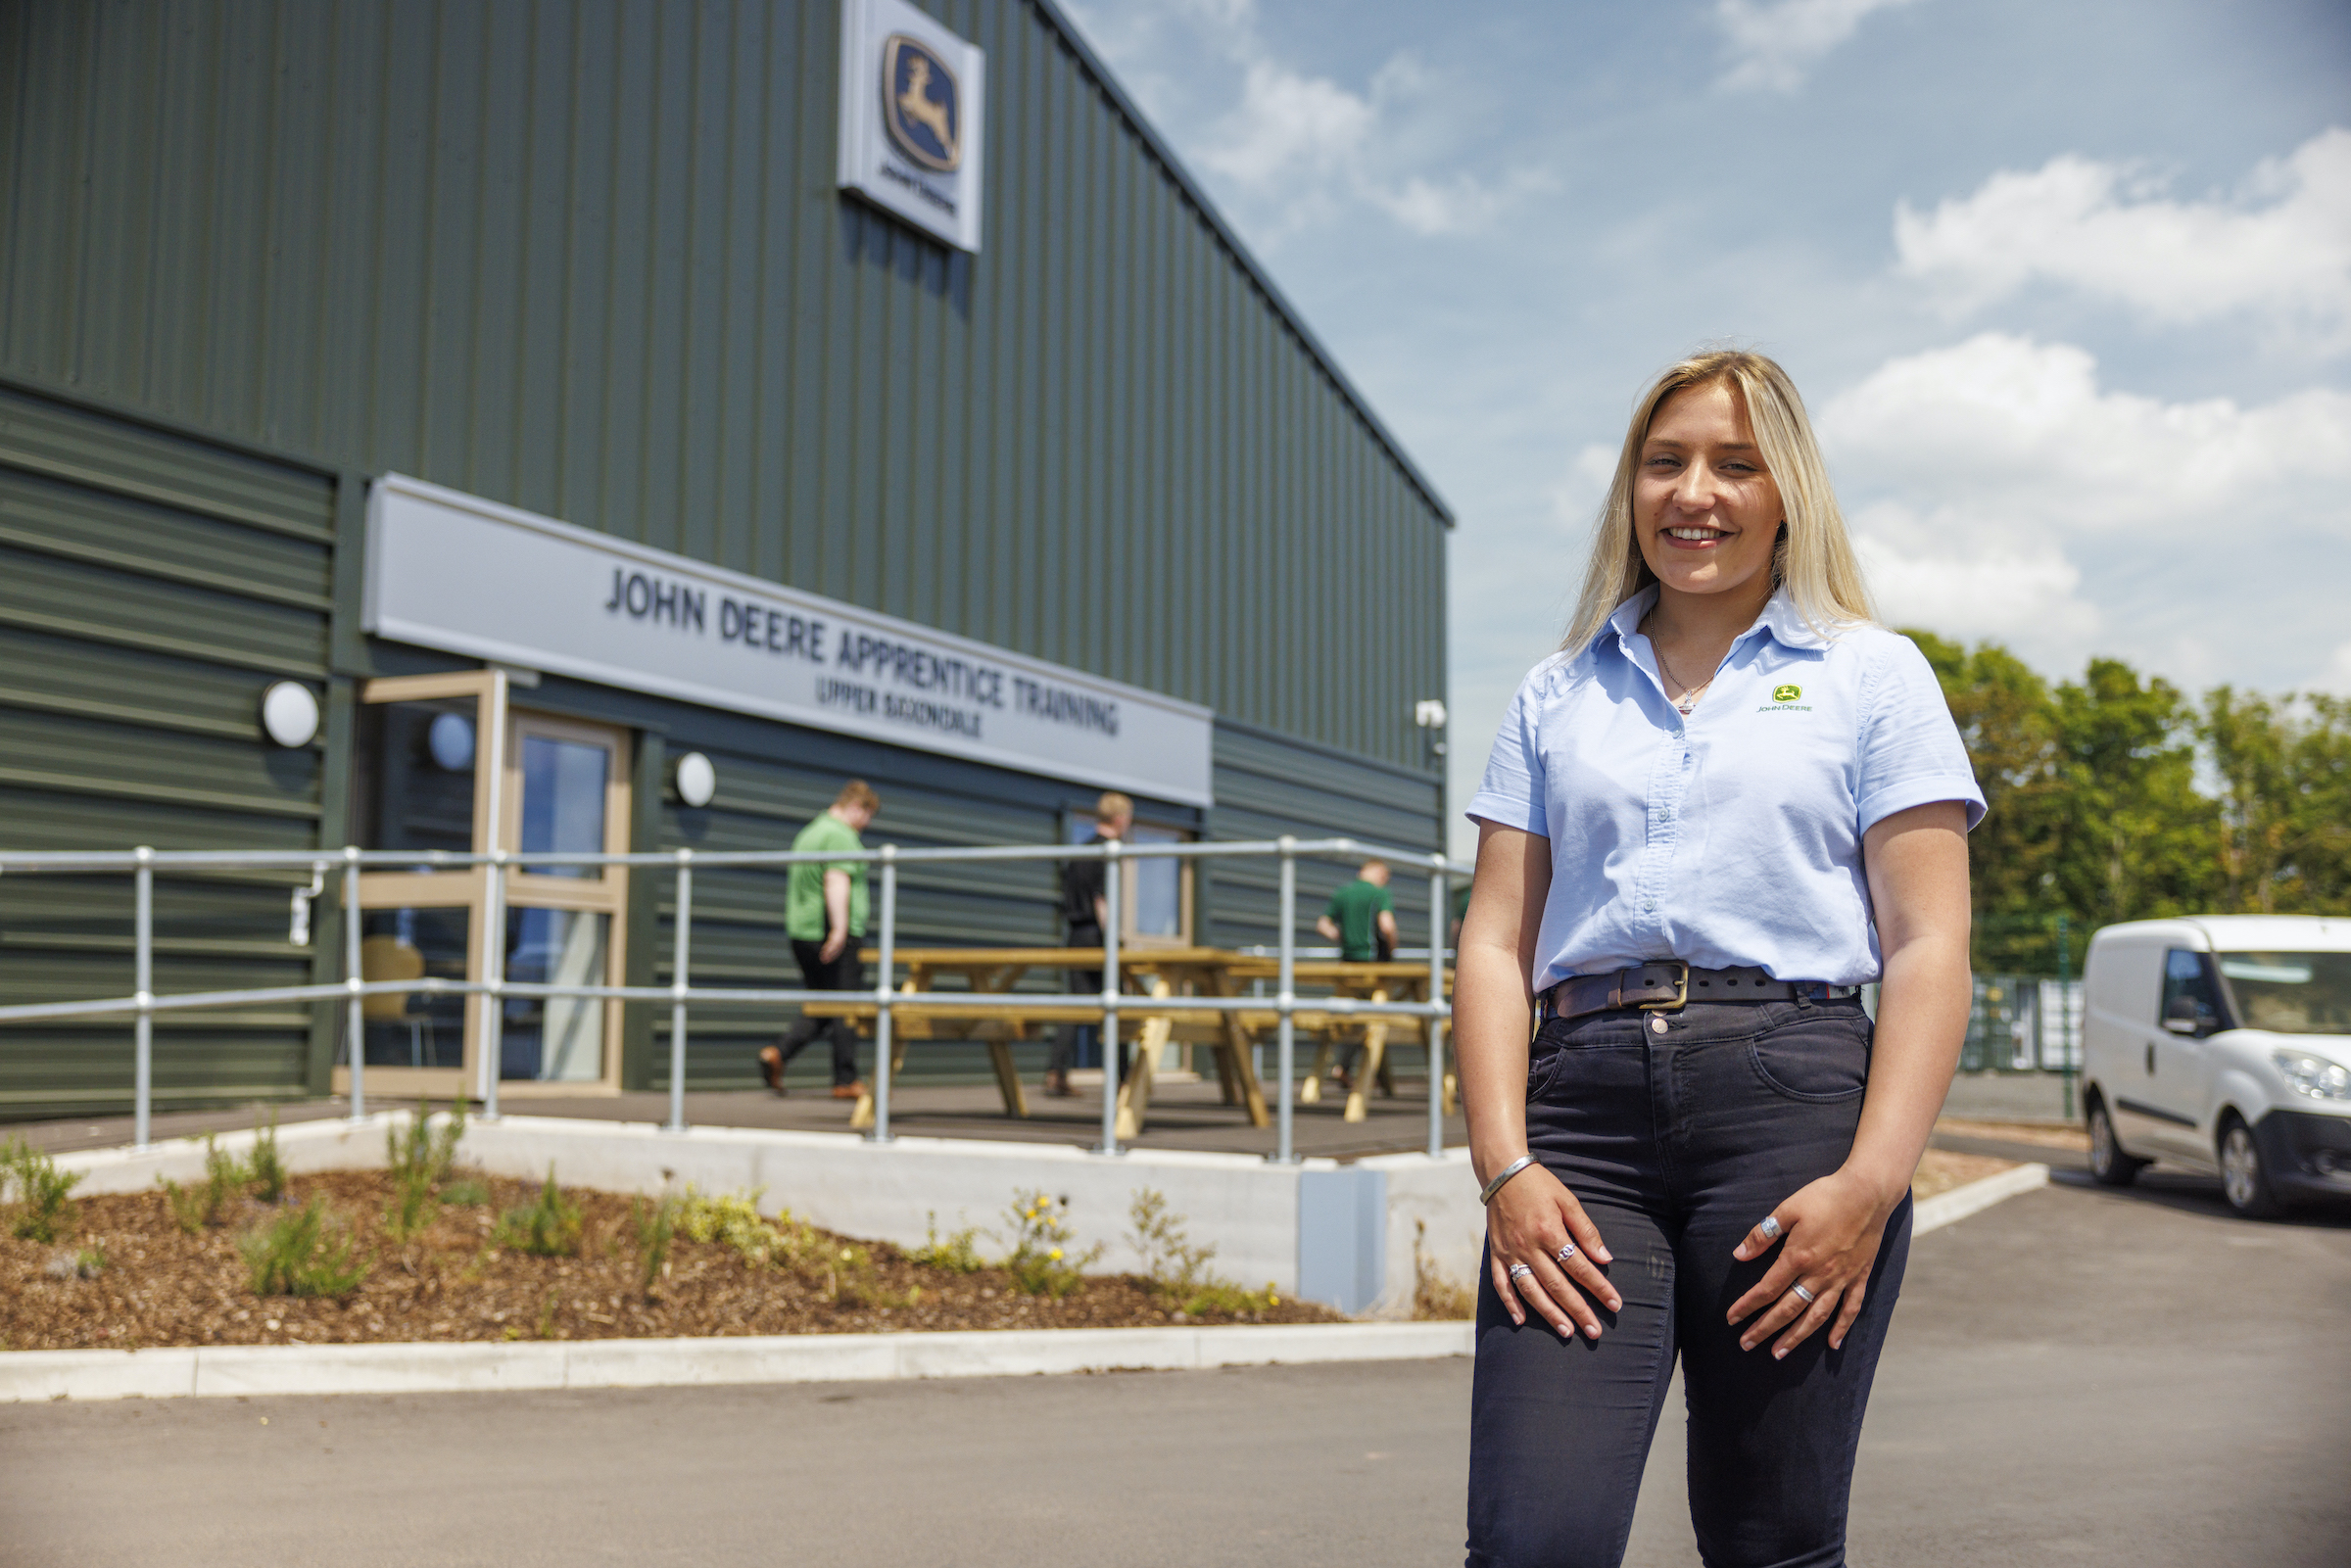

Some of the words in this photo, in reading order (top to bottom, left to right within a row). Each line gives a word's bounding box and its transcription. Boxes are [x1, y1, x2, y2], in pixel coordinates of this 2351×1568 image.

[605, 568, 704, 633] JOHN
[720, 596, 825, 663] DEERE
[838, 631, 1003, 709] APPRENTICE
[1013, 676, 1119, 736] TRAINING
[815, 676, 875, 713] UPPER
